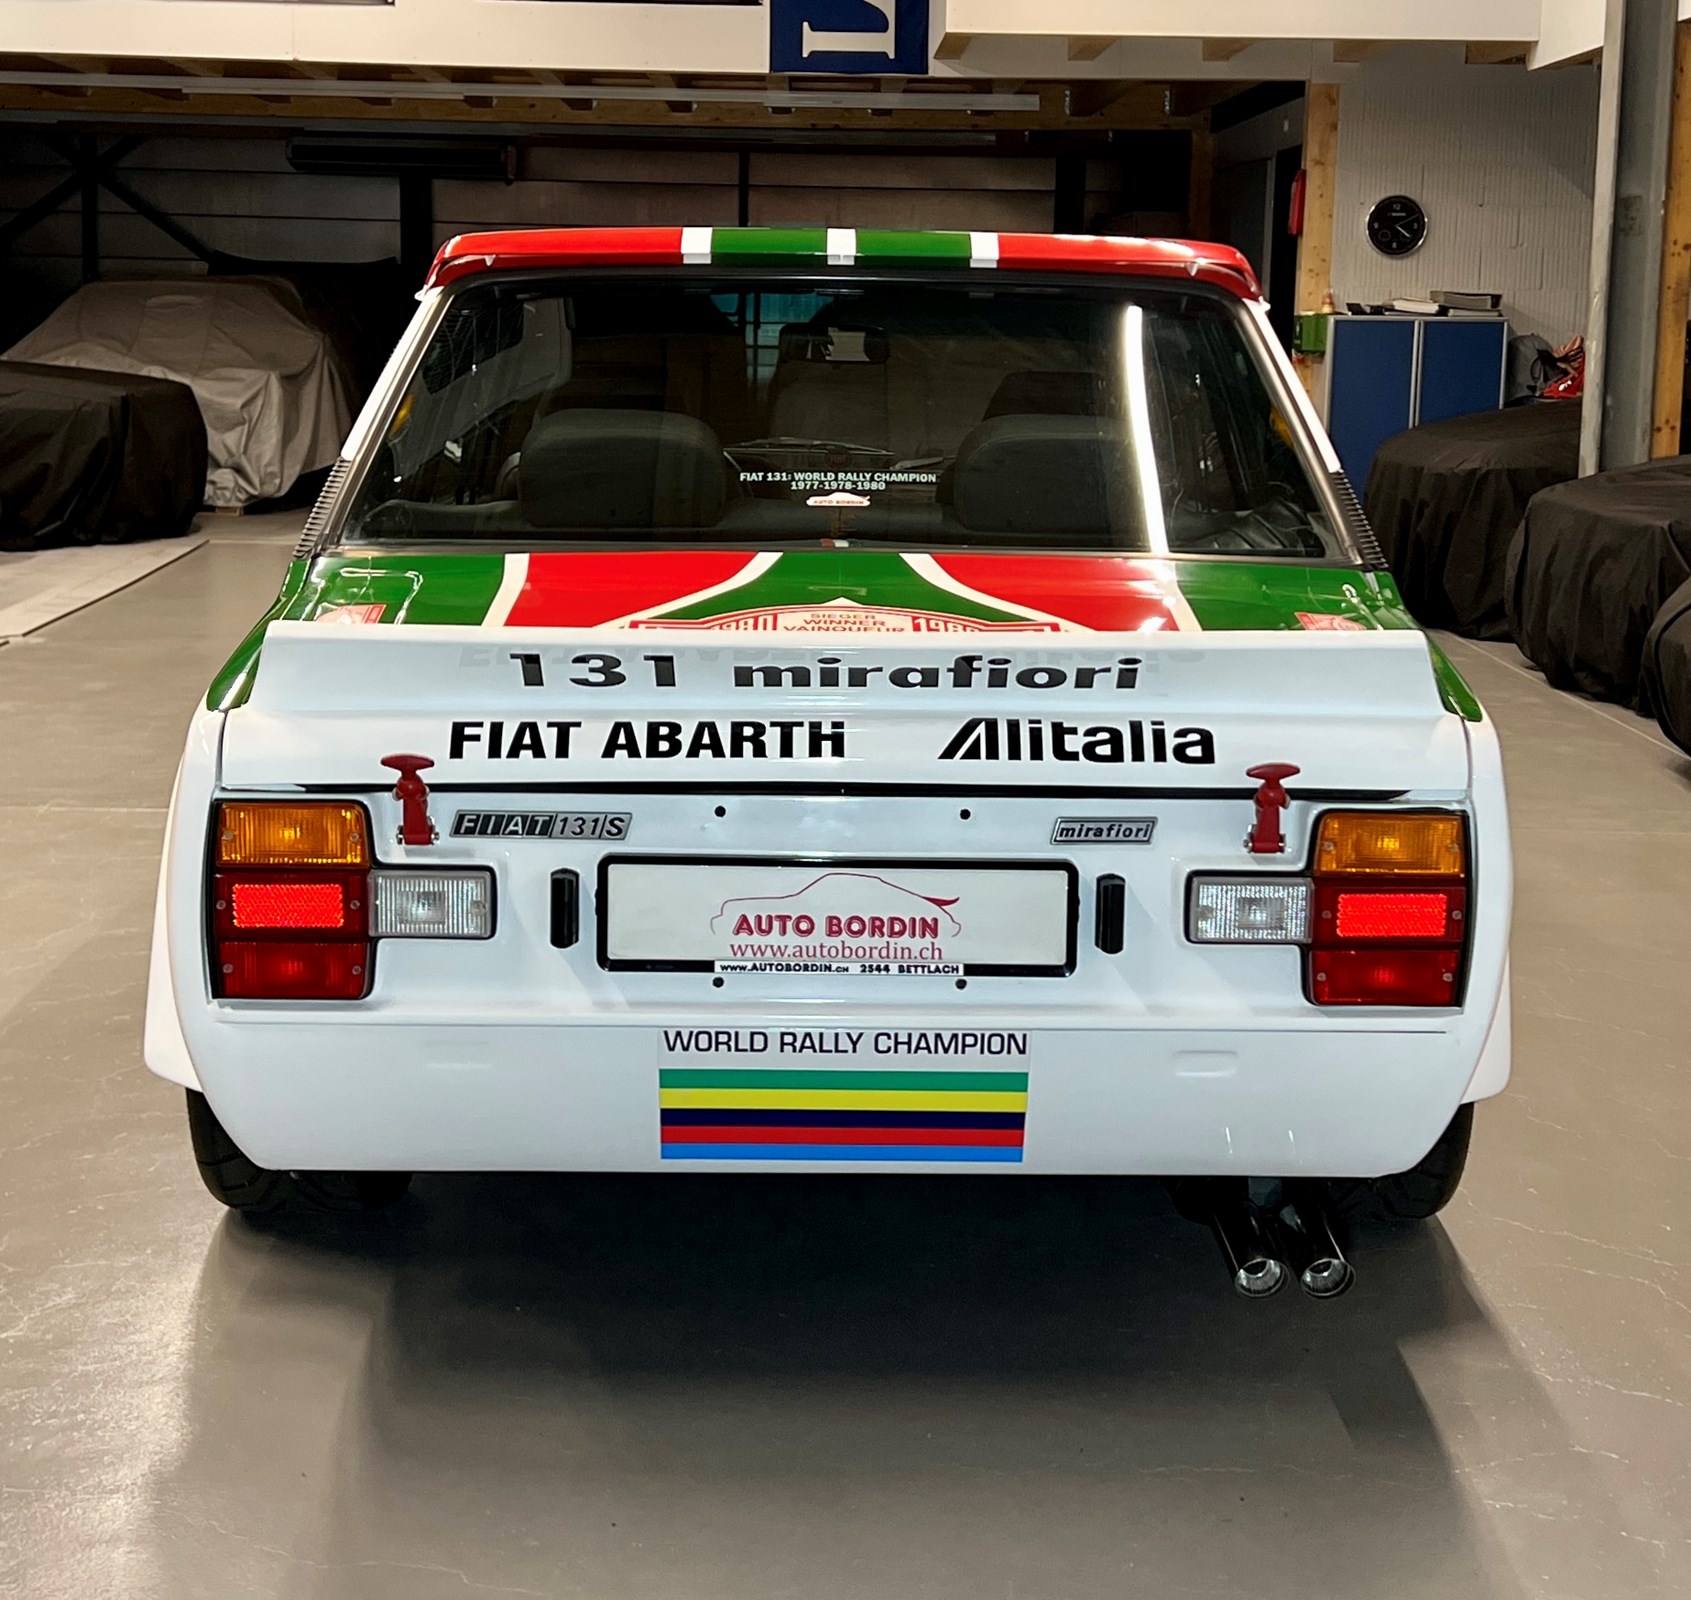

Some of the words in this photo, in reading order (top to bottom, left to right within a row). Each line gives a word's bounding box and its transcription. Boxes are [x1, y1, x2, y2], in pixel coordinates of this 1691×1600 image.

[739, 472, 765, 481] FIAT
[794, 472, 835, 482] WORLD
[837, 473, 871, 482] RALLY
[873, 473, 937, 483] CHAMPION
[790, 480, 886, 490] 1977-1978-1980
[803, 619, 886, 627] WINNER
[510, 653, 678, 688] 131
[733, 655, 1142, 689] mirafiori
[450, 721, 582, 760] FIAT
[602, 721, 845, 758] ABARTH
[938, 717, 1216, 765] Alitalia
[459, 814, 550, 836] FIAT
[1058, 823, 1151, 839] mirafiori
[732, 913, 816, 938] AUTO
[825, 914, 939, 939] BORDIN
[730, 940, 943, 961] www.autobordin.ch
[859, 963, 891, 974] 2544
[897, 964, 960, 975] BETTLACH
[663, 1030, 769, 1054] WORLD
[779, 1031, 864, 1055] RALLY
[873, 1032, 1028, 1055] CHAMPION
